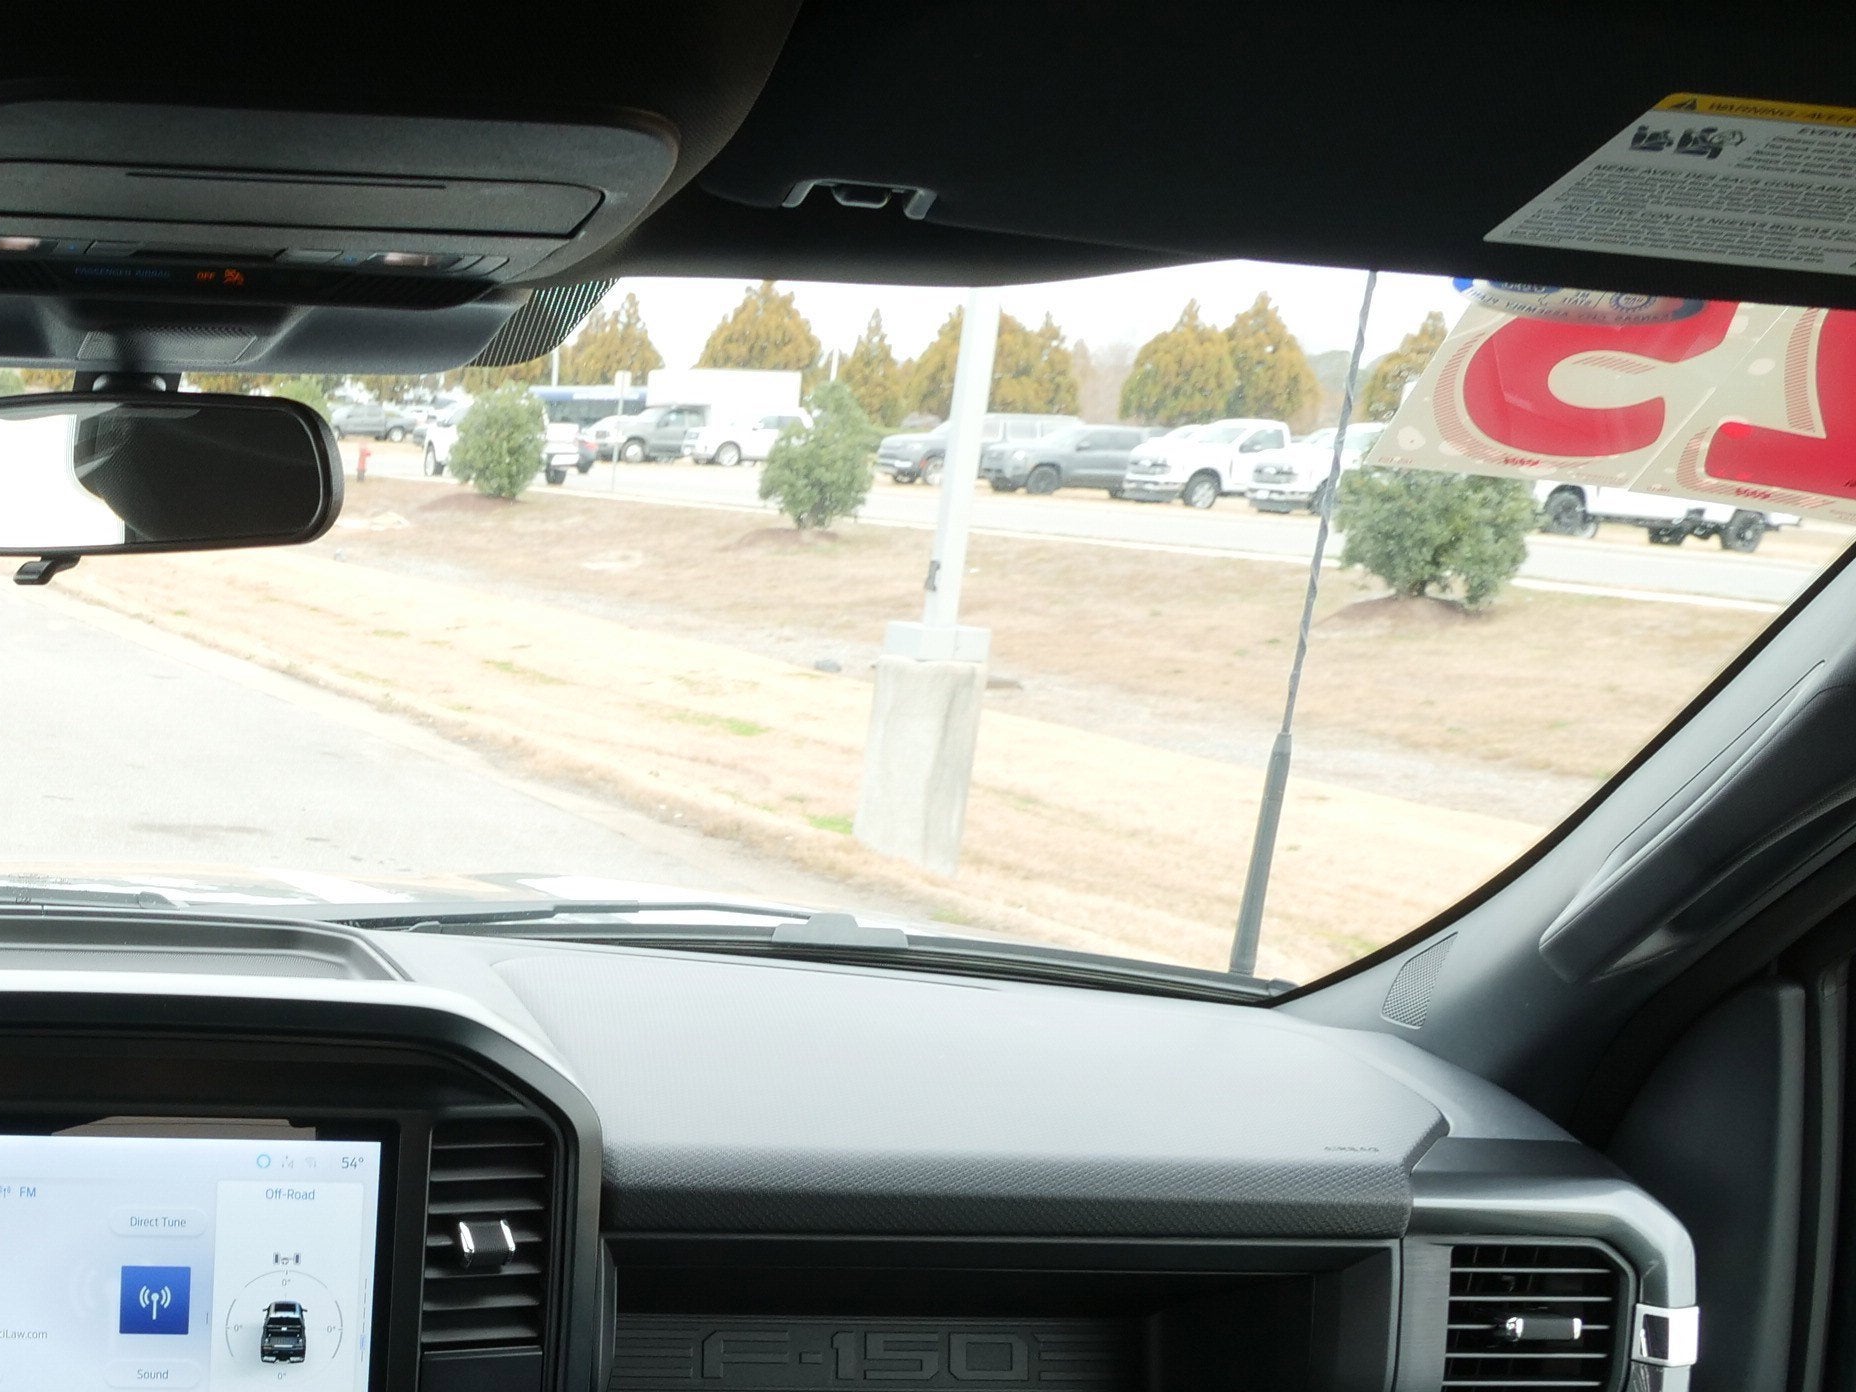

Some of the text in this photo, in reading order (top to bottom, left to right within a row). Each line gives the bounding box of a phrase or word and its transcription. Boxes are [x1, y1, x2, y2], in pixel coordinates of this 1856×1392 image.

[19, 1187, 37, 1198] FM
[265, 1188, 315, 1201] Off-Road
[129, 1215, 186, 1229] Direct Tune
[701, 1328, 1030, 1382] F-150
[136, 1367, 169, 1381] Sound
